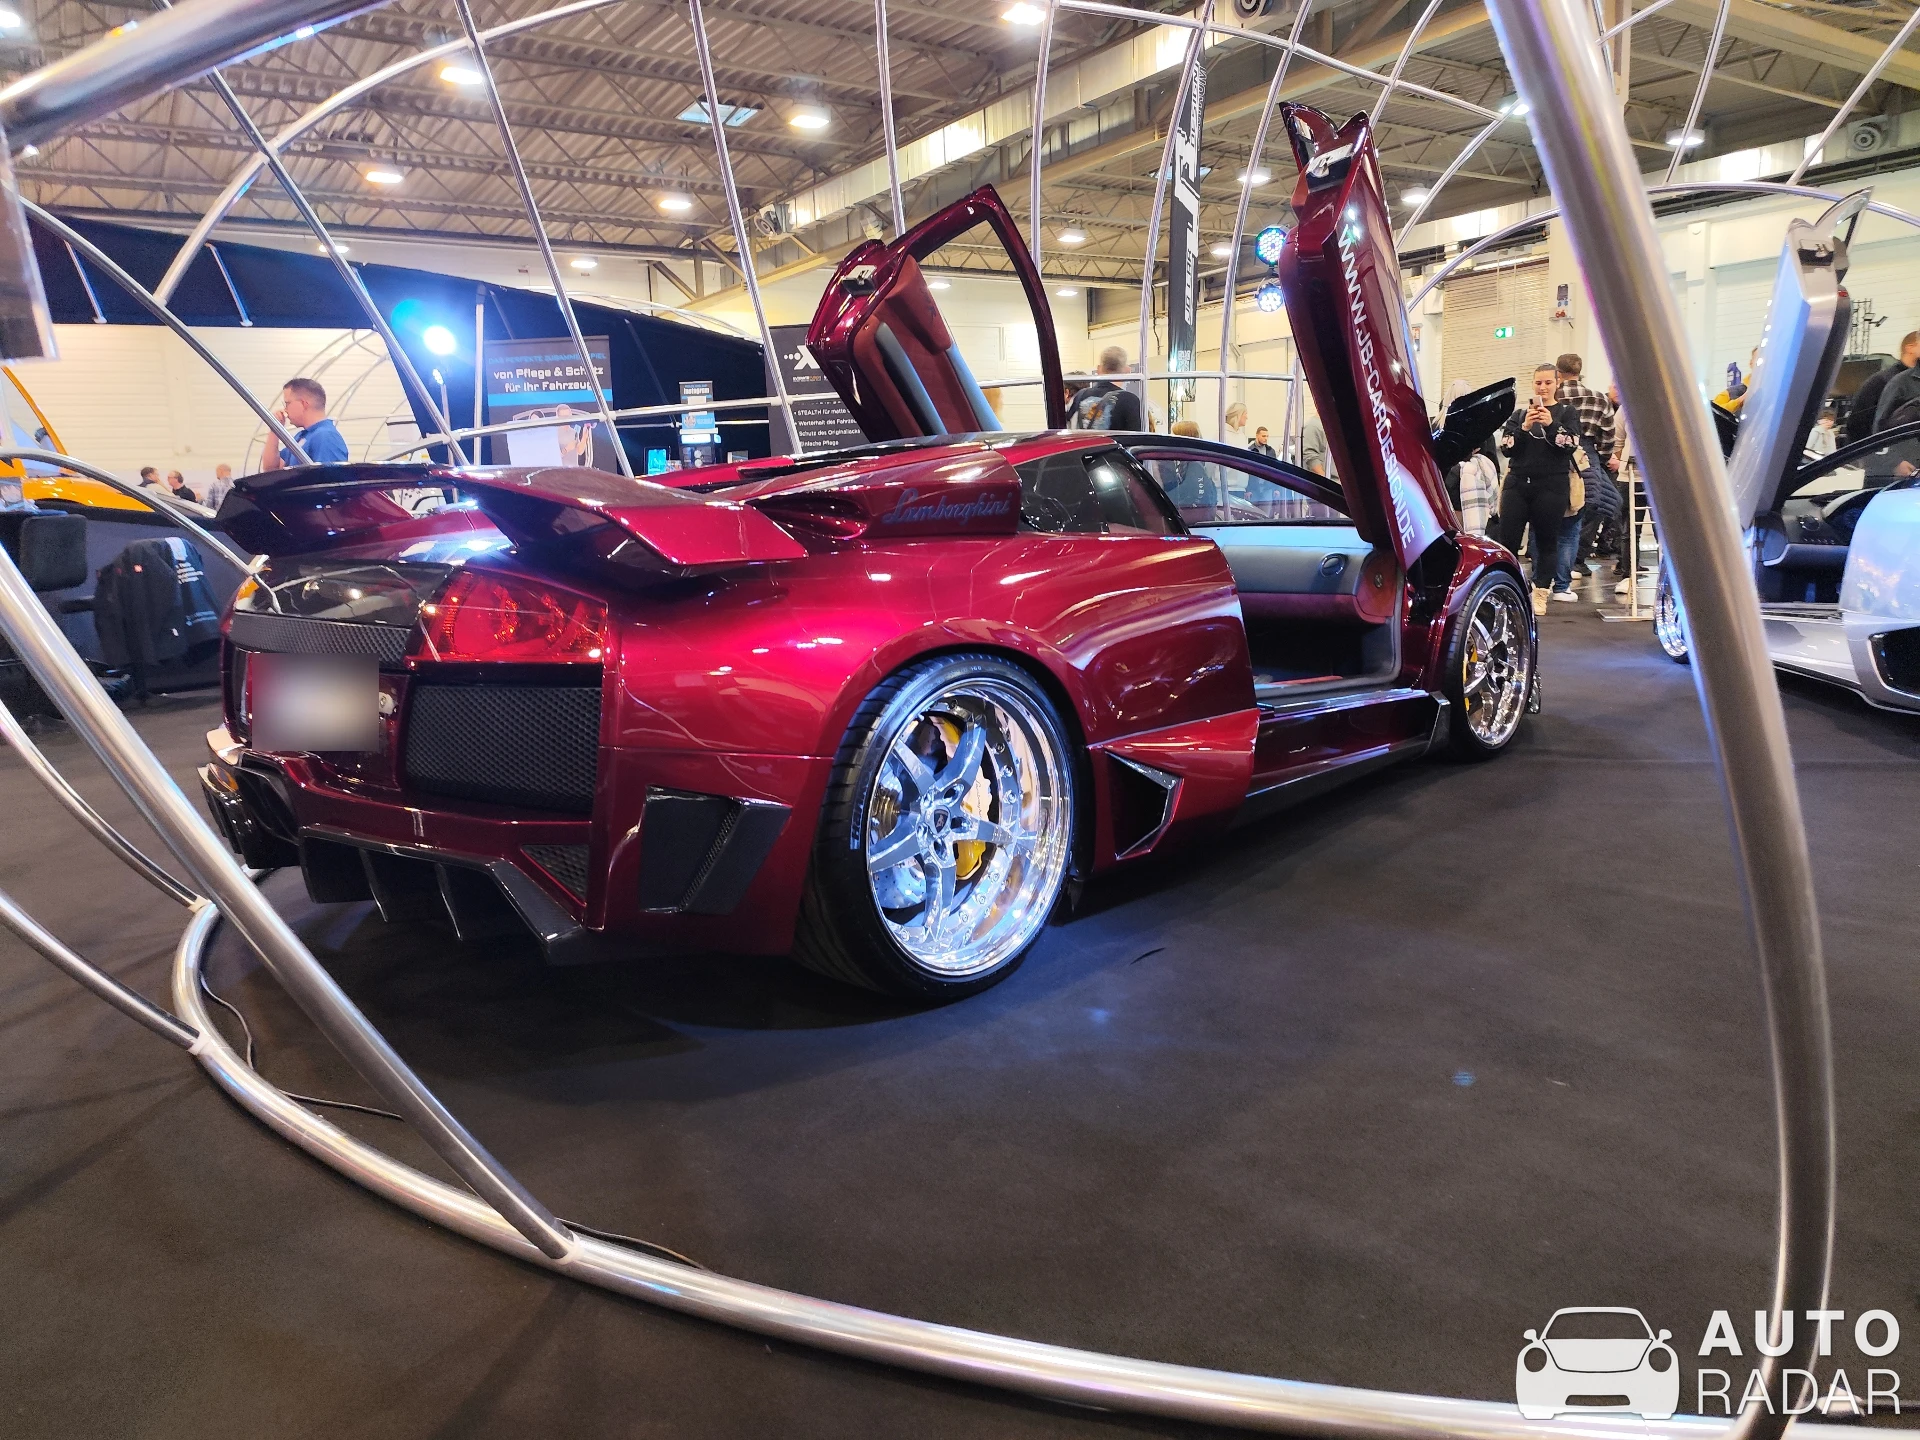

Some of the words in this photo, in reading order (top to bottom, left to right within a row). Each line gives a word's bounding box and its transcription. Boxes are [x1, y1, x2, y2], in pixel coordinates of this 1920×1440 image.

[494, 370, 513, 380] von
[516, 368, 551, 379] Pflege
[554, 366, 562, 377] &
[565, 366, 604, 376] Schtz
[505, 382, 521, 393] für
[523, 381, 539, 392] Ihr
[1338, 224, 1415, 549] WWW.JB-CARDESIGN.DE
[882, 487, 1012, 525] Lamborghini
